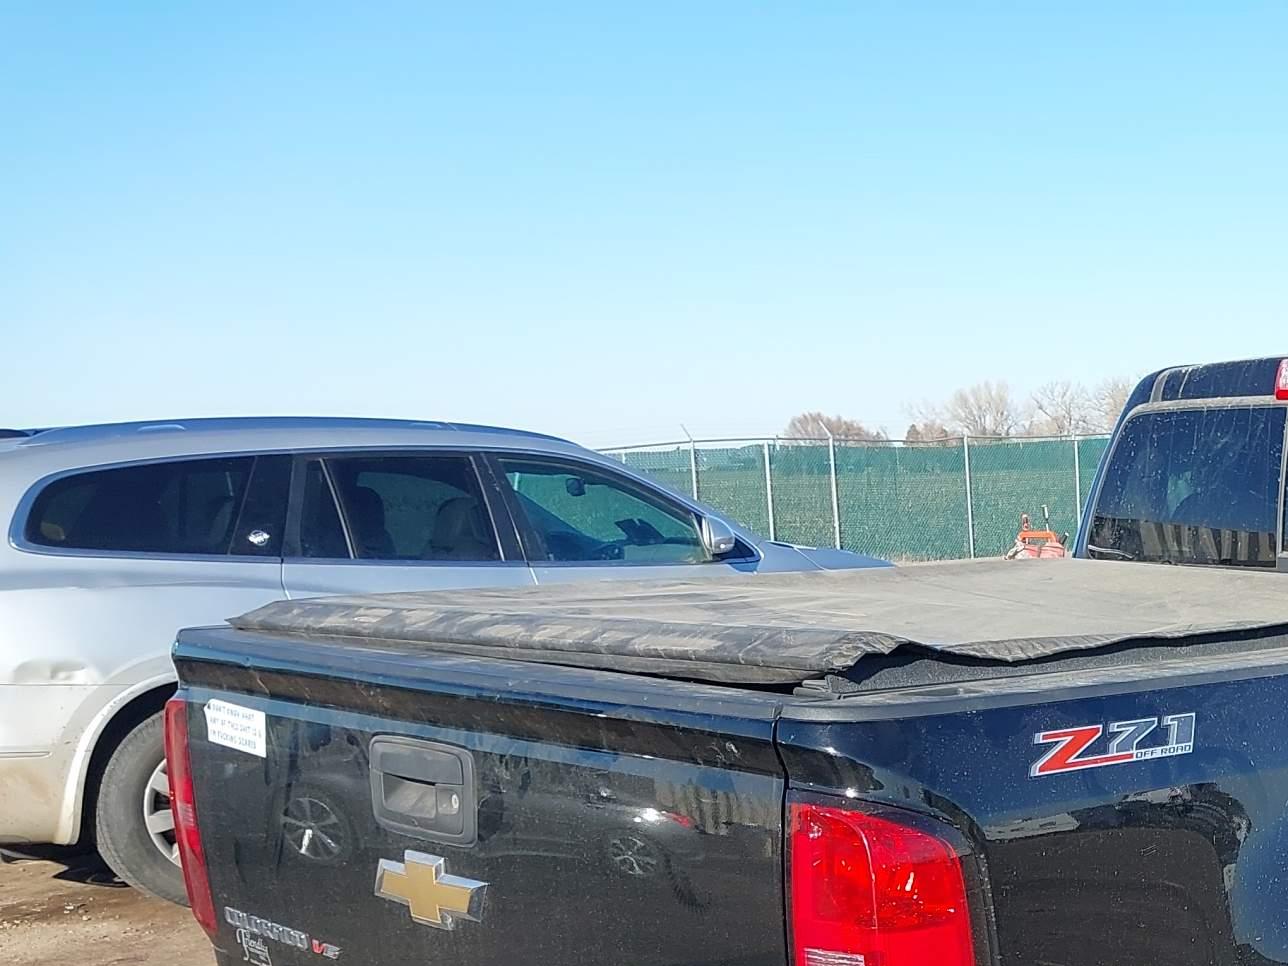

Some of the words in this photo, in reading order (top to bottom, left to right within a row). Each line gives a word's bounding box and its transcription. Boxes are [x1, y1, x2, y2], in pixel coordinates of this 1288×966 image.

[1029, 712, 1196, 777] Z71
[1135, 748, 1159, 760] OFF
[1160, 744, 1192, 756] ROAD
